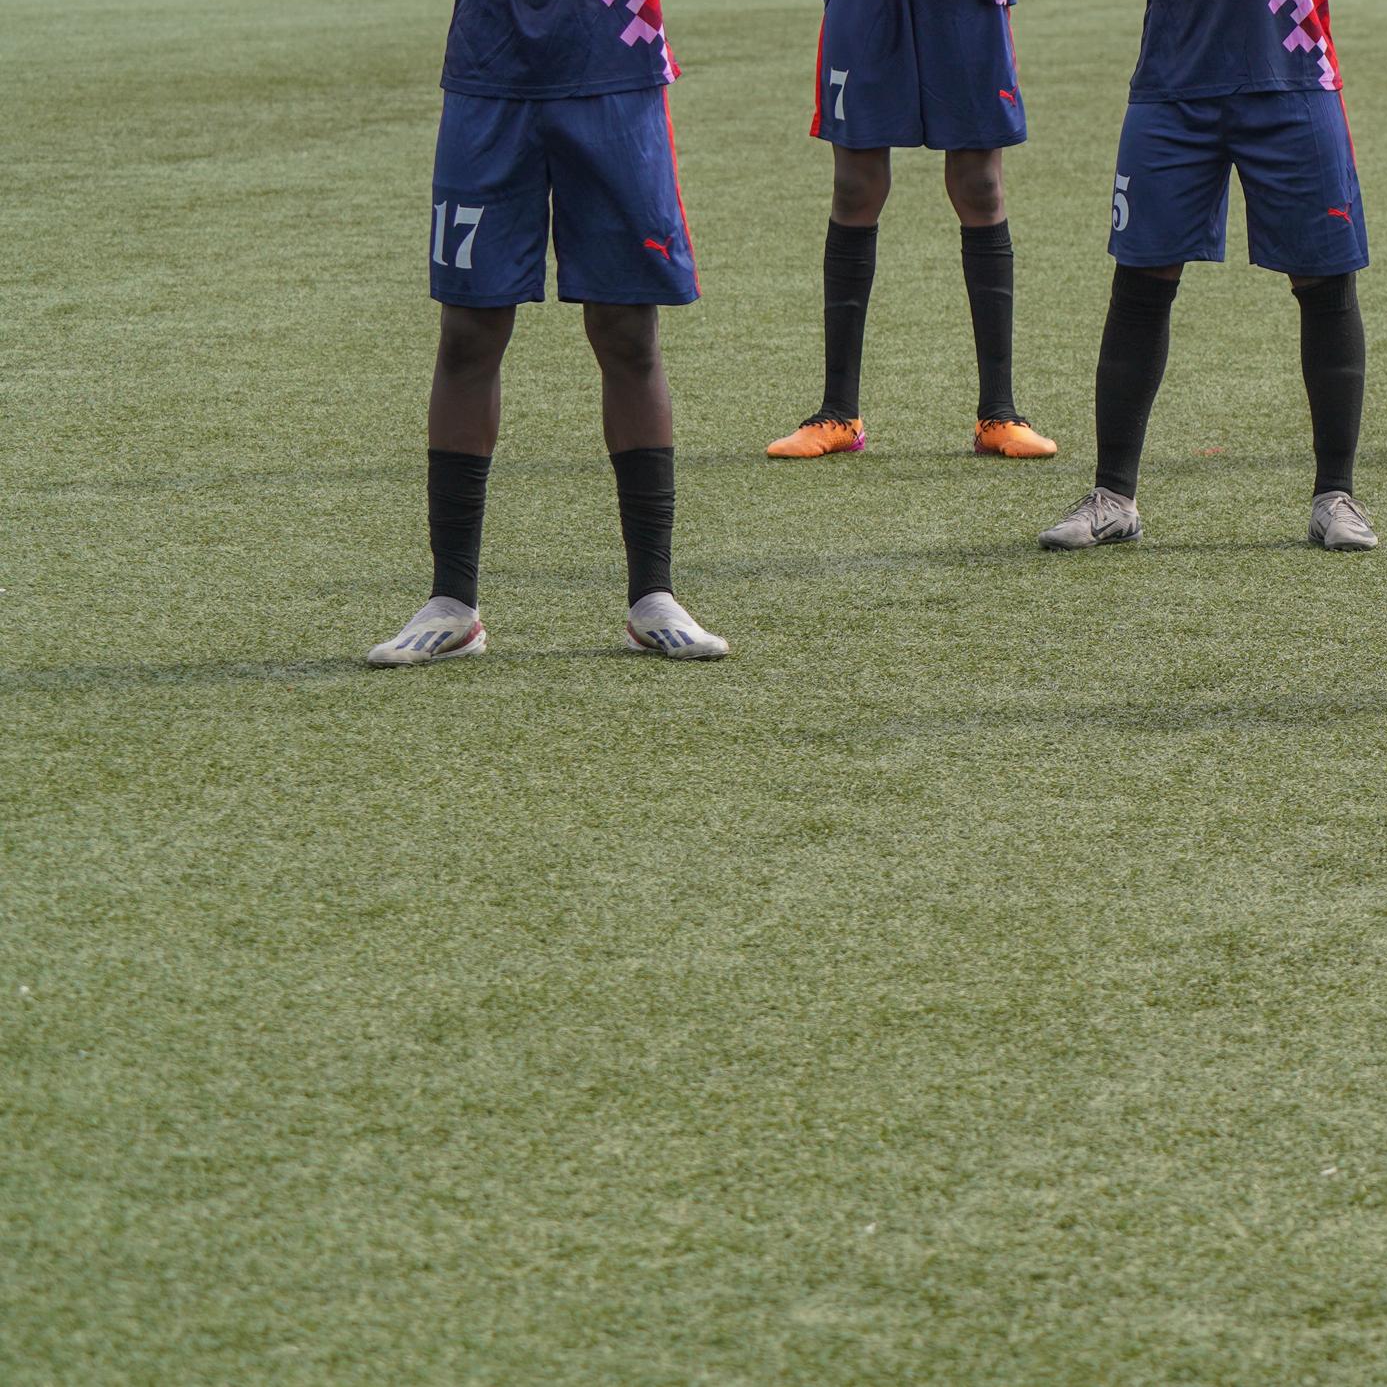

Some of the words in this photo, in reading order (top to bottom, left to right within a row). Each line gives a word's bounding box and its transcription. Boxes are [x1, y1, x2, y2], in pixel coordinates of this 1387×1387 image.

[829, 68, 849, 121] 7
[1112, 173, 1131, 232] 5
[433, 200, 485, 269] 17
